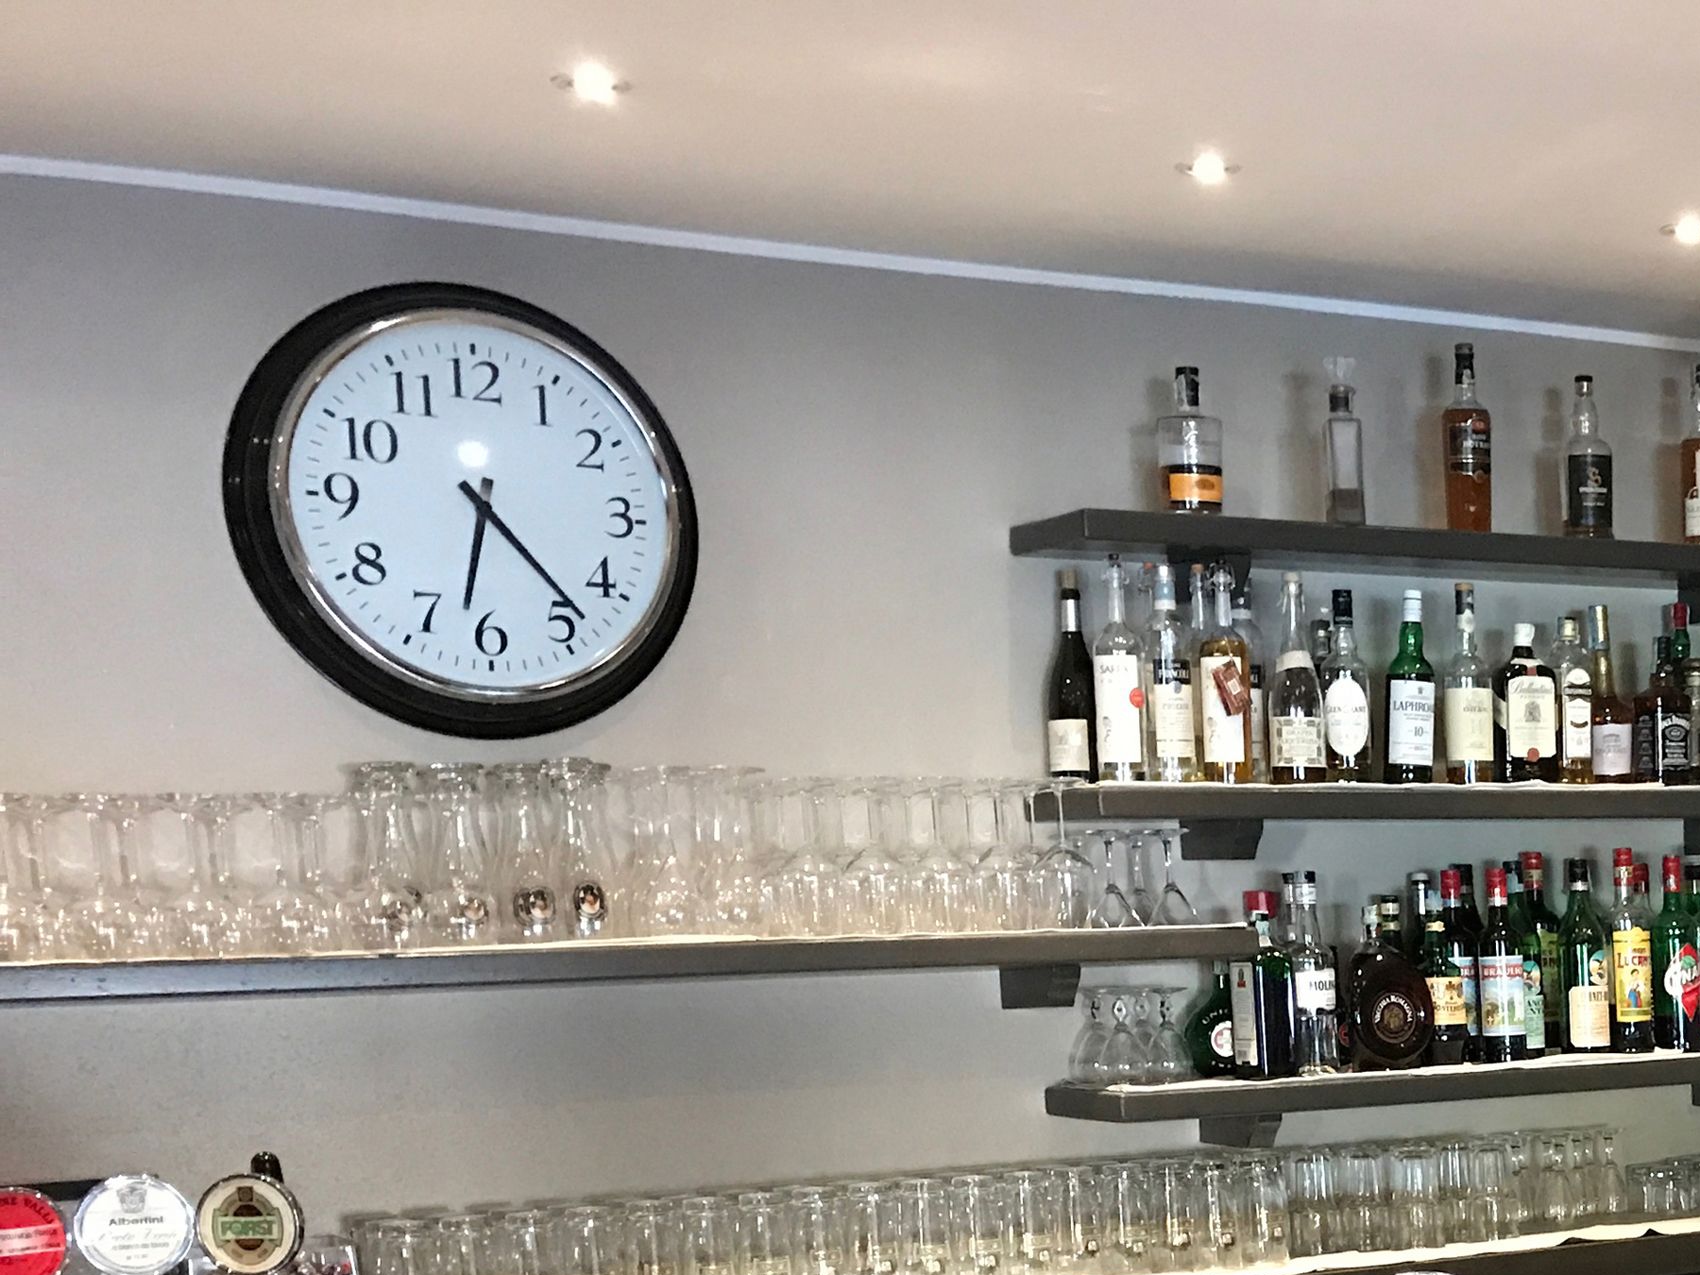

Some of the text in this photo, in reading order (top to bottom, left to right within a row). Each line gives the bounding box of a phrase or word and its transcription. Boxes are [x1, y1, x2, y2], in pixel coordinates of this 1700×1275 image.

[391, 370, 438, 418] 11
[447, 357, 503, 405] 12
[532, 384, 553, 427] 1
[341, 416, 399, 464] 10
[575, 428, 606, 472] 2
[323, 472, 360, 520] 9
[605, 497, 634, 539] 3
[351, 542, 388, 586] 8
[585, 556, 617, 599] 4
[413, 590, 442, 634] 7
[474, 610, 509, 657] 6
[547, 600, 577, 643] 5
[1414, 726, 1424, 737] 10
[220, 1220, 275, 1237] FORST
